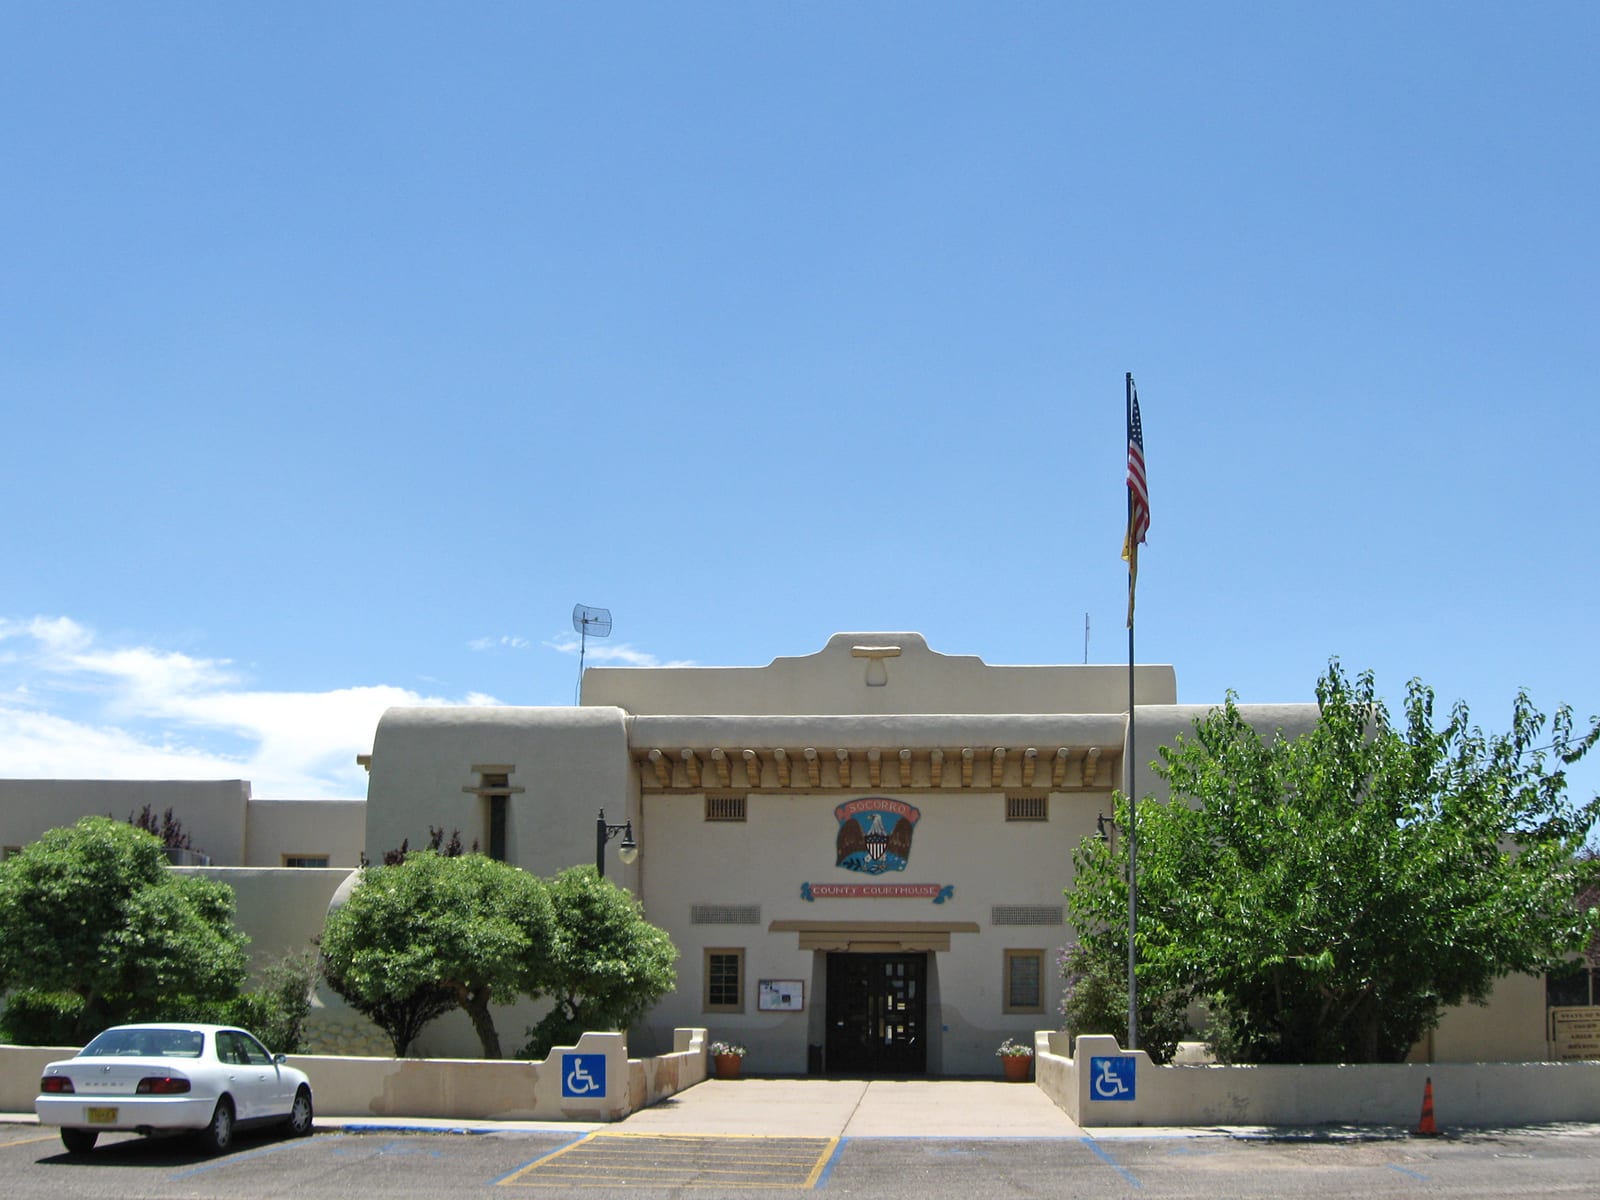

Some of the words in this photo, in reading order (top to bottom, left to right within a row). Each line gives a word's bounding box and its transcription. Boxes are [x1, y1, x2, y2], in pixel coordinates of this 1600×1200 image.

[849, 800, 907, 814] SOCORRO
[812, 886, 857, 896] COUNTY
[862, 886, 936, 896] COURTHOUSE
